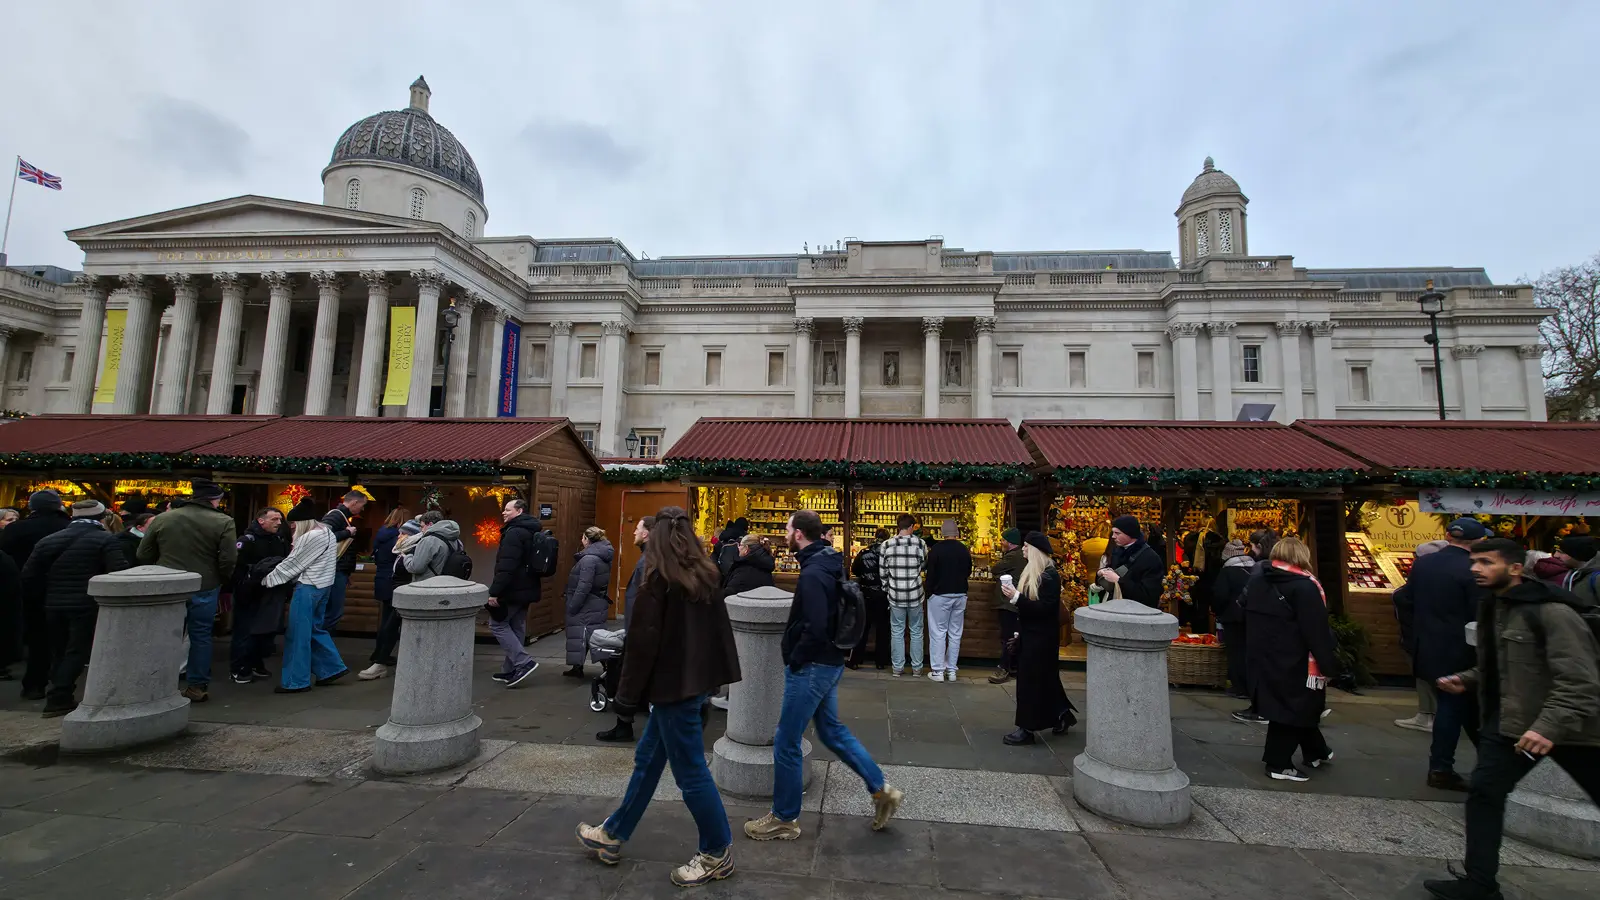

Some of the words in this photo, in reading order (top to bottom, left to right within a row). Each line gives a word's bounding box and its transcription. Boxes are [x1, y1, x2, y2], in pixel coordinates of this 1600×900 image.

[157, 251, 185, 261] THE
[194, 250, 273, 260] NATIONAL
[284, 248, 356, 259] GALLERY
[110, 325, 119, 370] NATIONAL
[395, 324, 403, 370] NATIONAL
[402, 324, 411, 370] GALLERY
[506, 329, 515, 375] HARMONY
[503, 377, 511, 413] RADICAL
[1490, 491, 1536, 508] Made
[1542, 493, 1577, 514] with
[1367, 530, 1398, 543] unky
